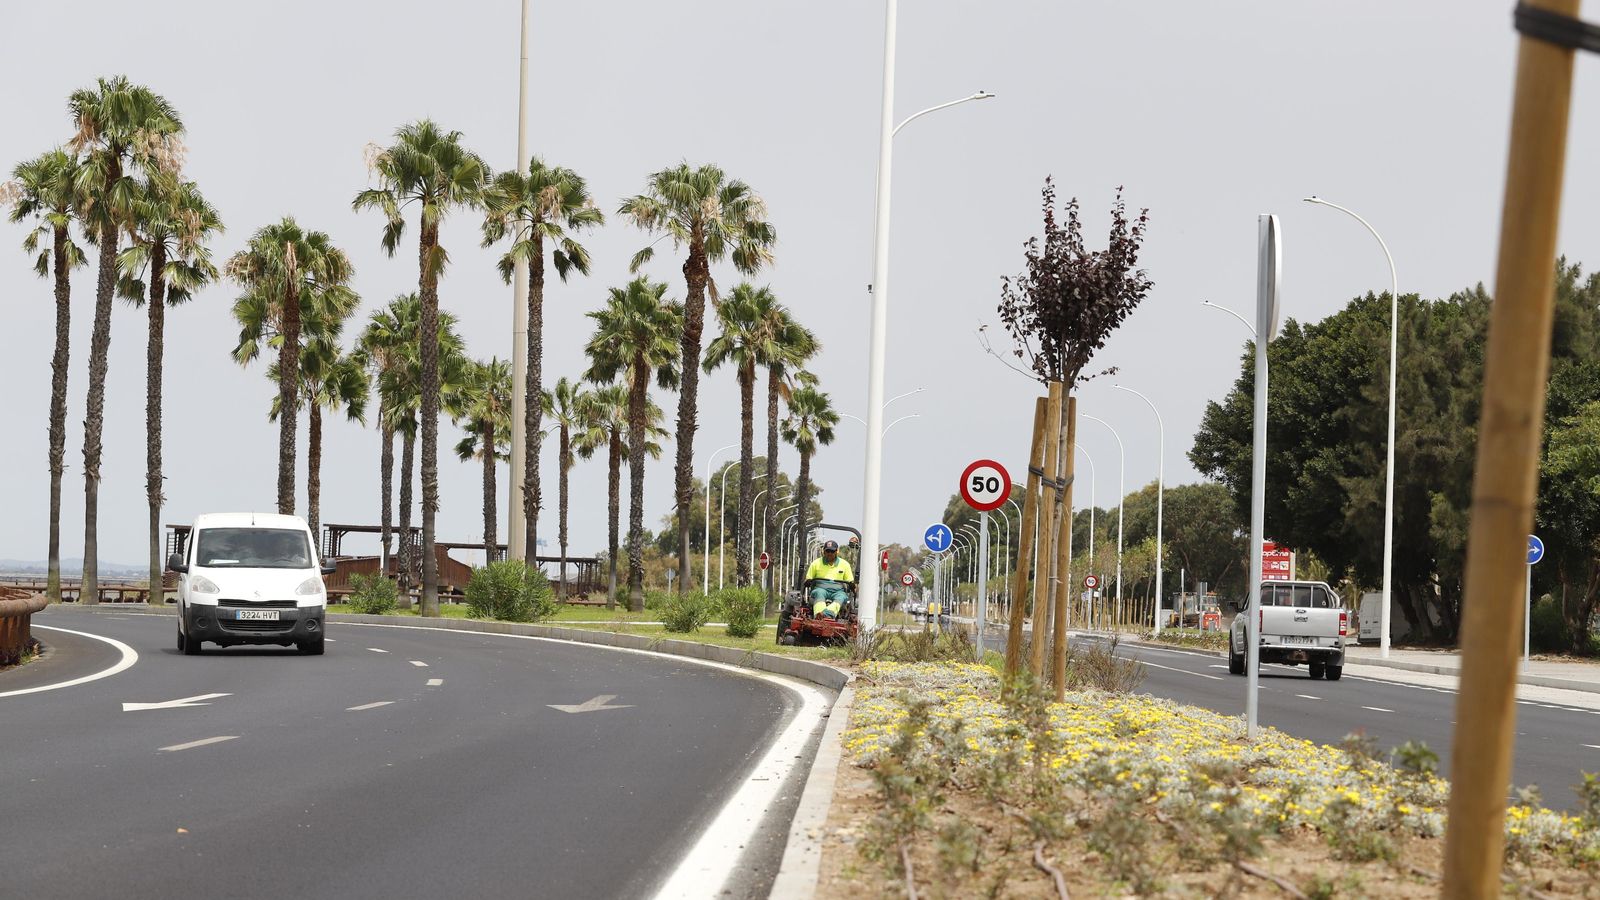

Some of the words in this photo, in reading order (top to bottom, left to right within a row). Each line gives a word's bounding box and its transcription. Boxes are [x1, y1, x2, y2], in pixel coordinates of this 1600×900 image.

[972, 476, 999, 493] 50
[241, 611, 260, 619] 3224
[262, 611, 277, 619] HVT
